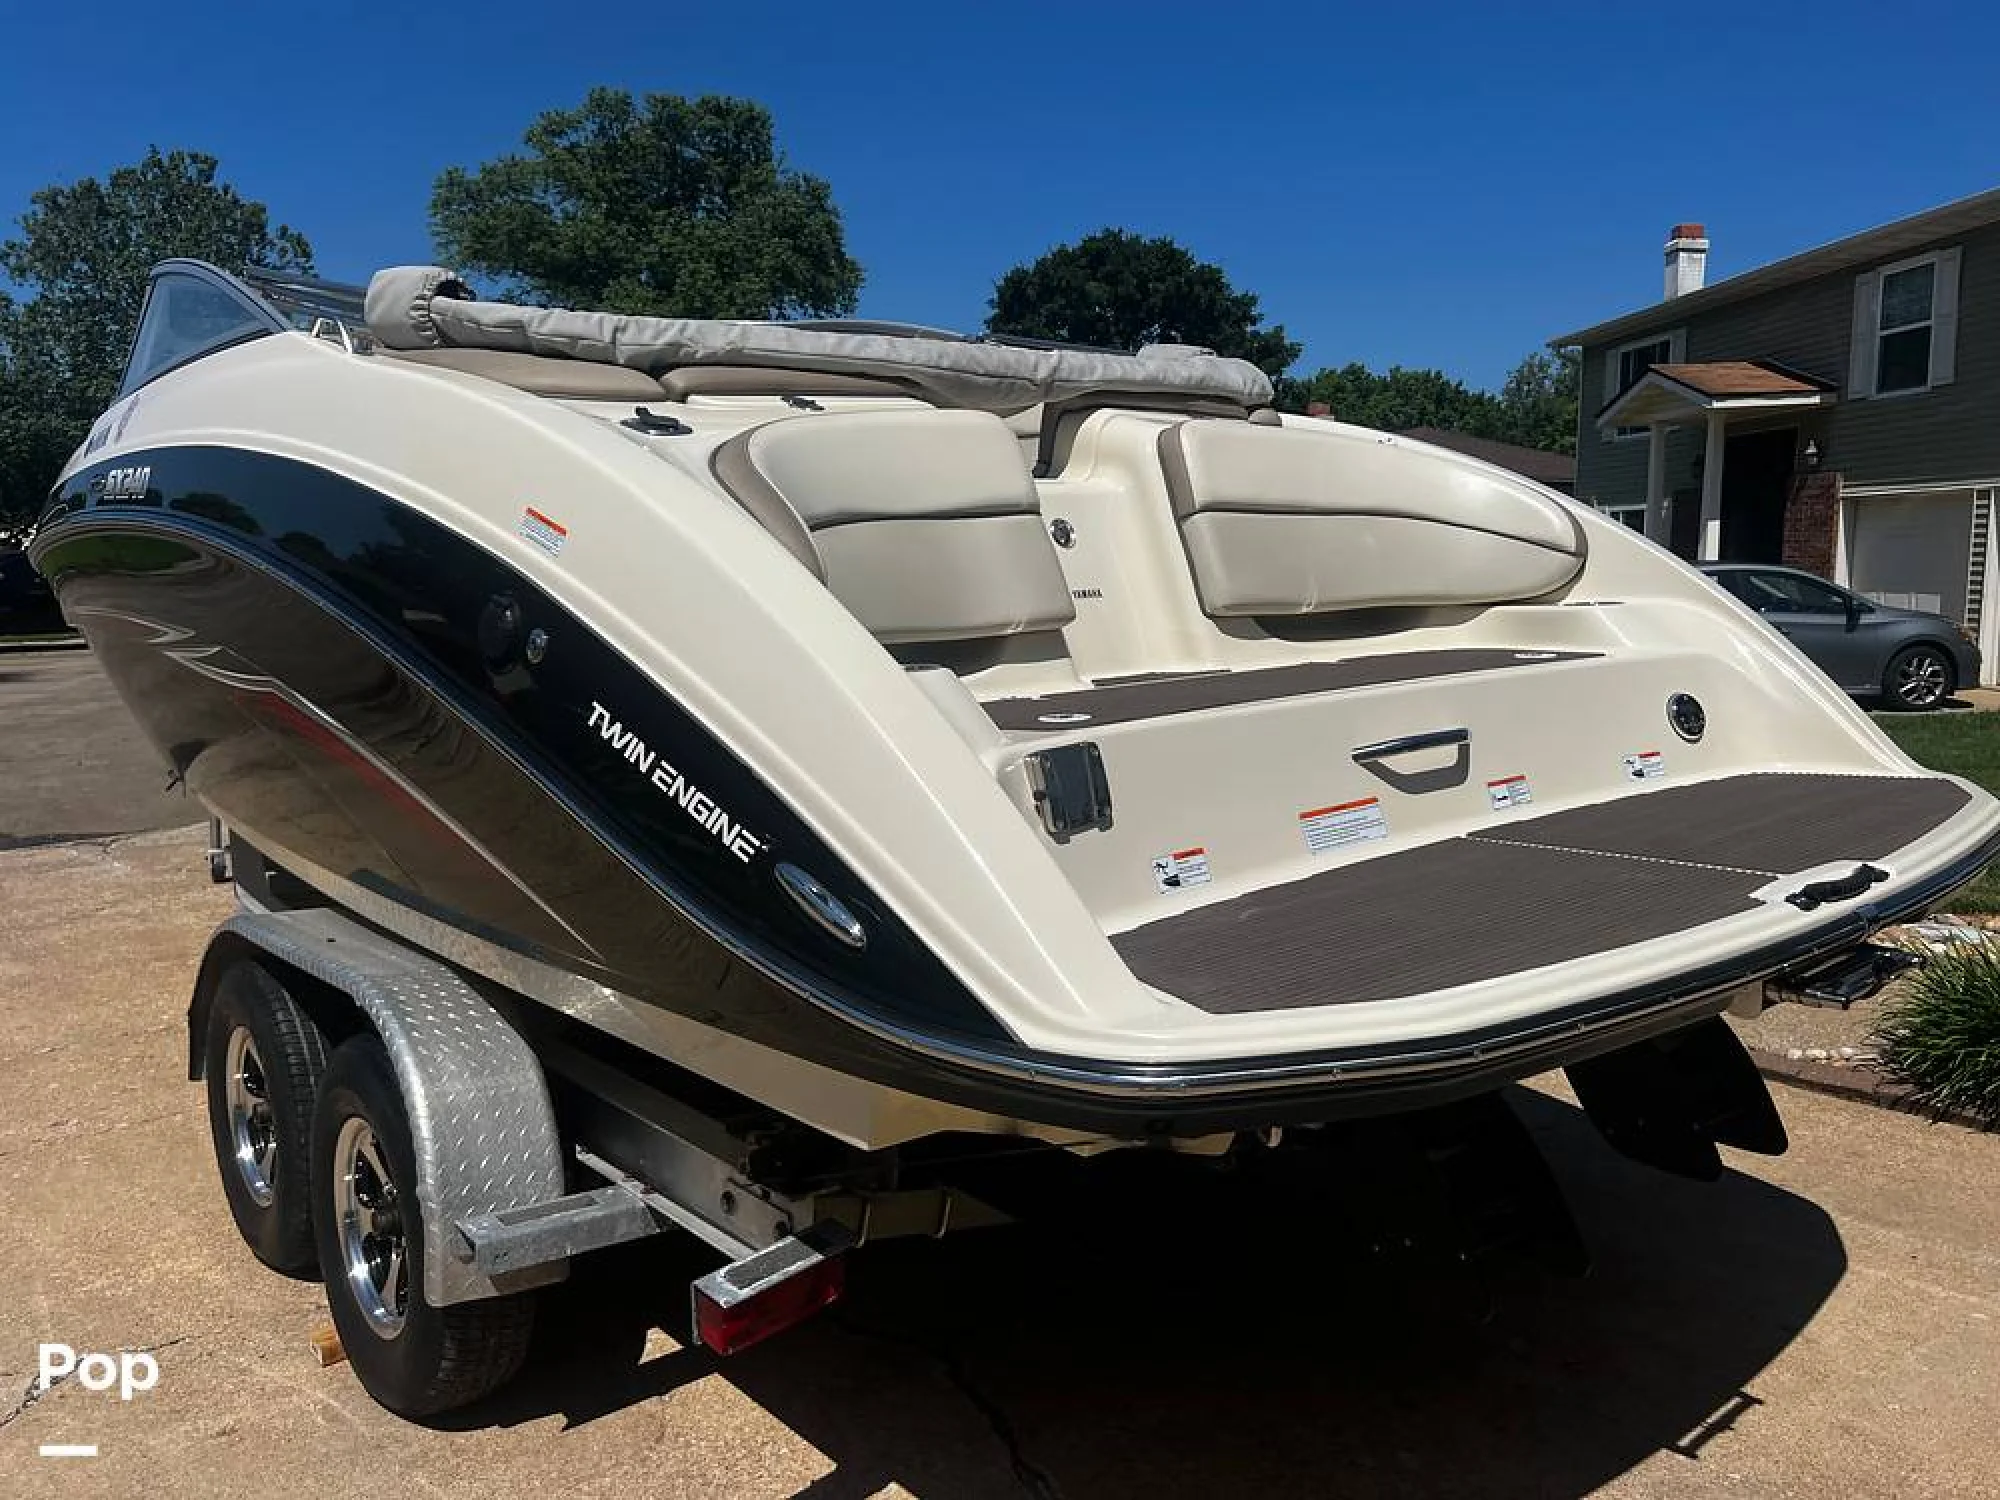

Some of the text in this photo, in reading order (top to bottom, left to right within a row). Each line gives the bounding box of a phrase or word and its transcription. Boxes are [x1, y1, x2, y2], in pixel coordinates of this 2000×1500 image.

[1071, 588, 1103, 599] YAMAHA
[588, 700, 761, 863] TWIN ENGINE
